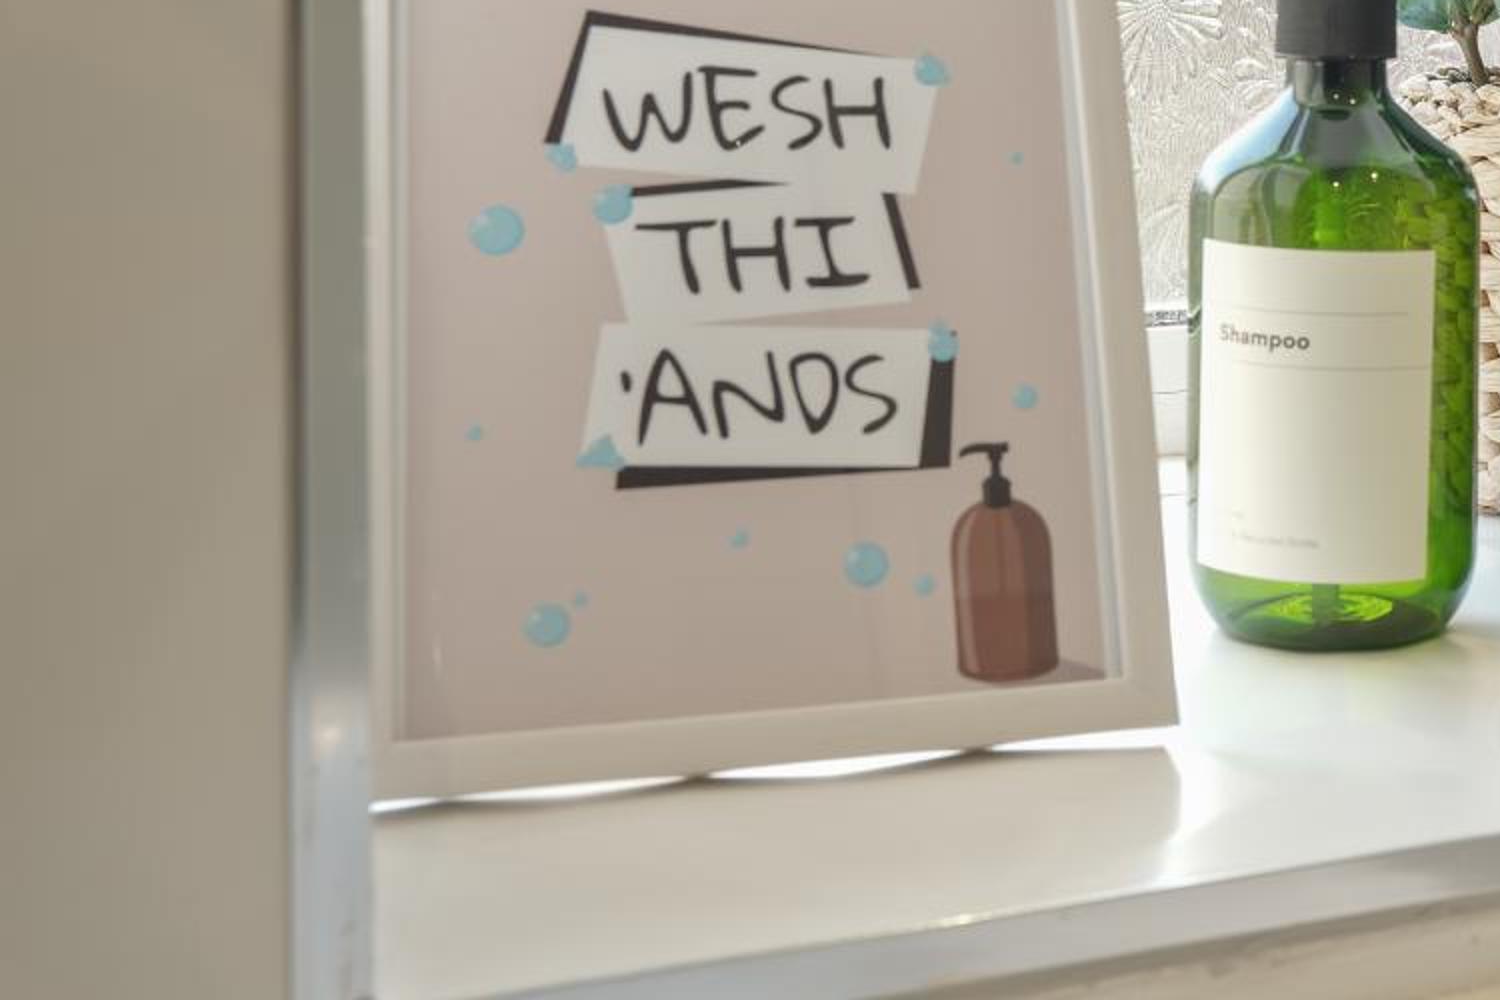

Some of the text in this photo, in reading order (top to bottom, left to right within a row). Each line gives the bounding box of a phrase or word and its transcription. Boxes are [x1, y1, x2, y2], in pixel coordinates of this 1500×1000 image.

[602, 65, 891, 153] WESH
[635, 216, 870, 295] THI
[1220, 323, 1310, 352] Shampoo
[621, 347, 898, 446] 'ANDS
